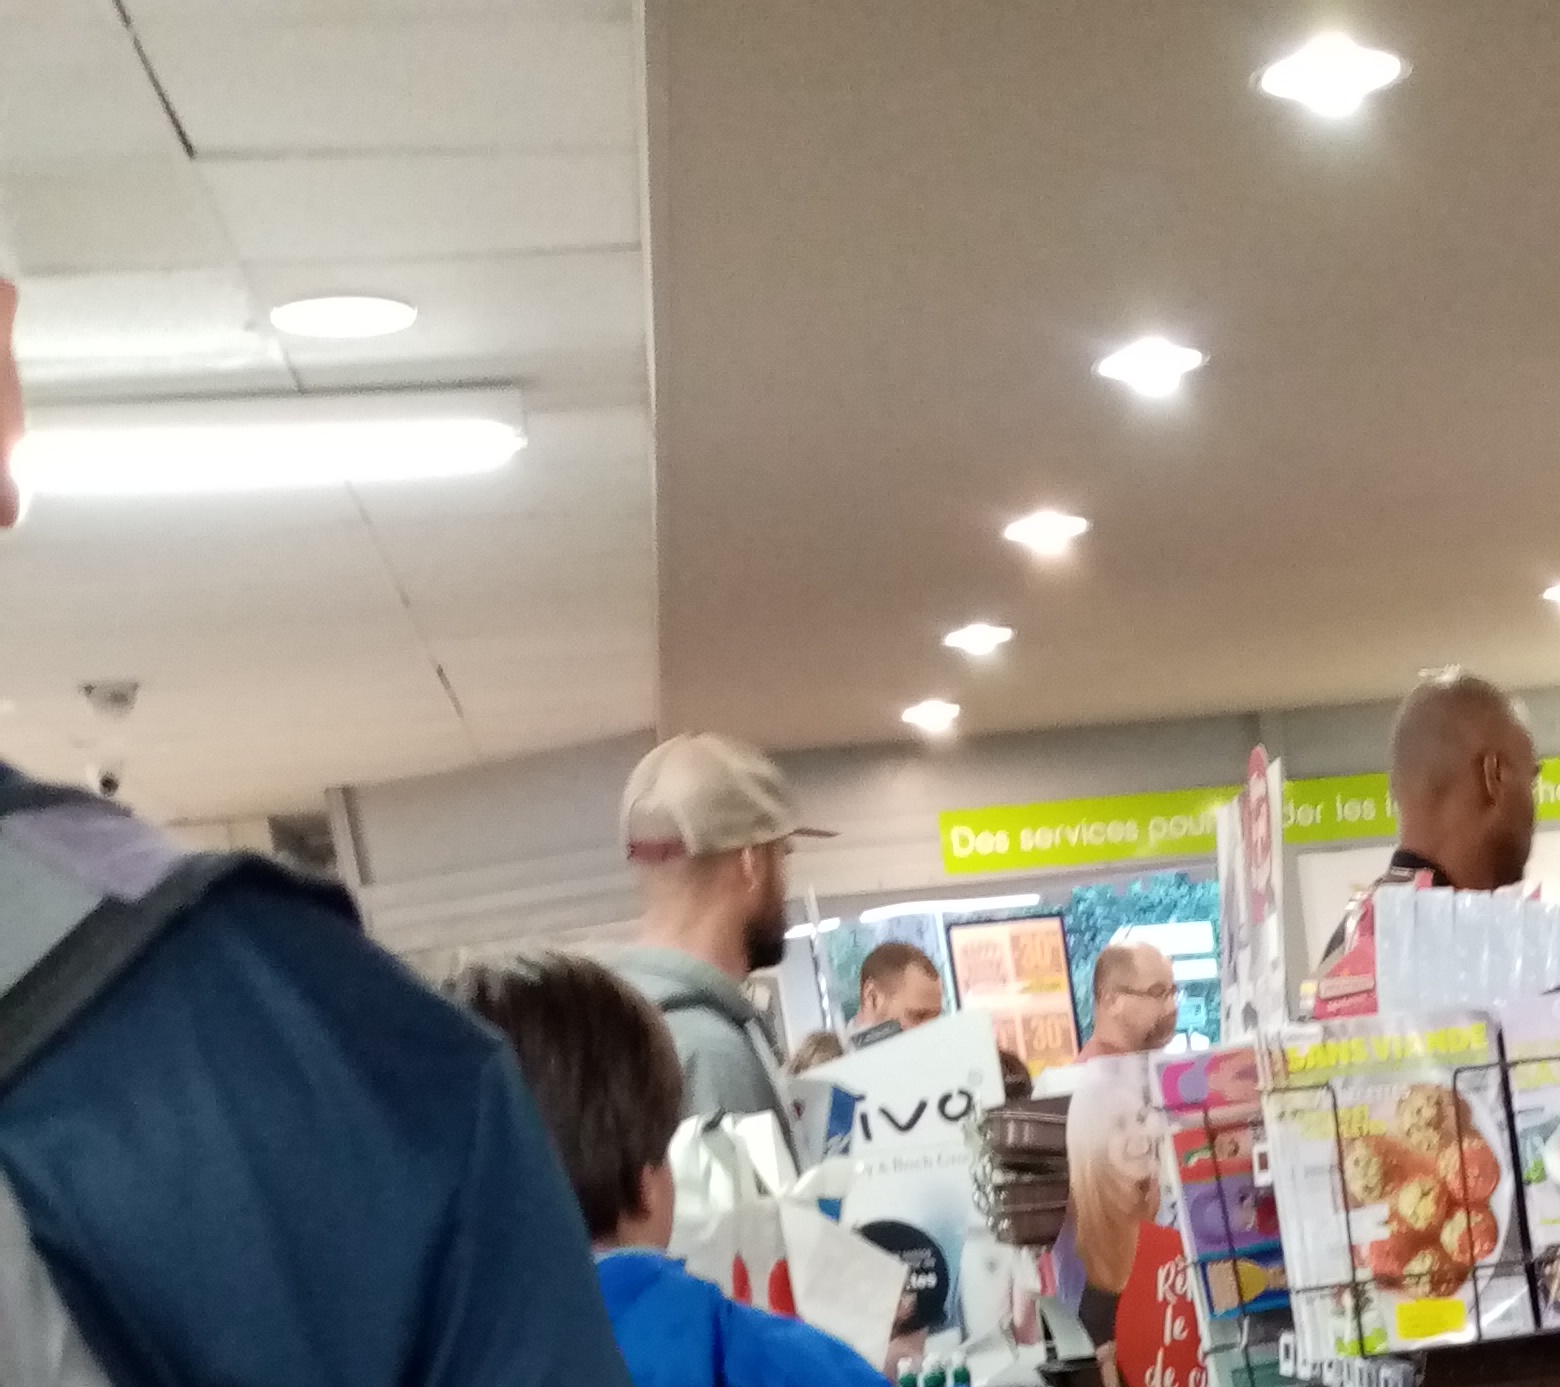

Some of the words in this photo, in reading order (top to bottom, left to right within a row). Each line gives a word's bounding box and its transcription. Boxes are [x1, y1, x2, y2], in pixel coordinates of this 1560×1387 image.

[951, 825, 1010, 858] Des
[1019, 817, 1139, 853] services
[859, 1088, 973, 1142] ivo
